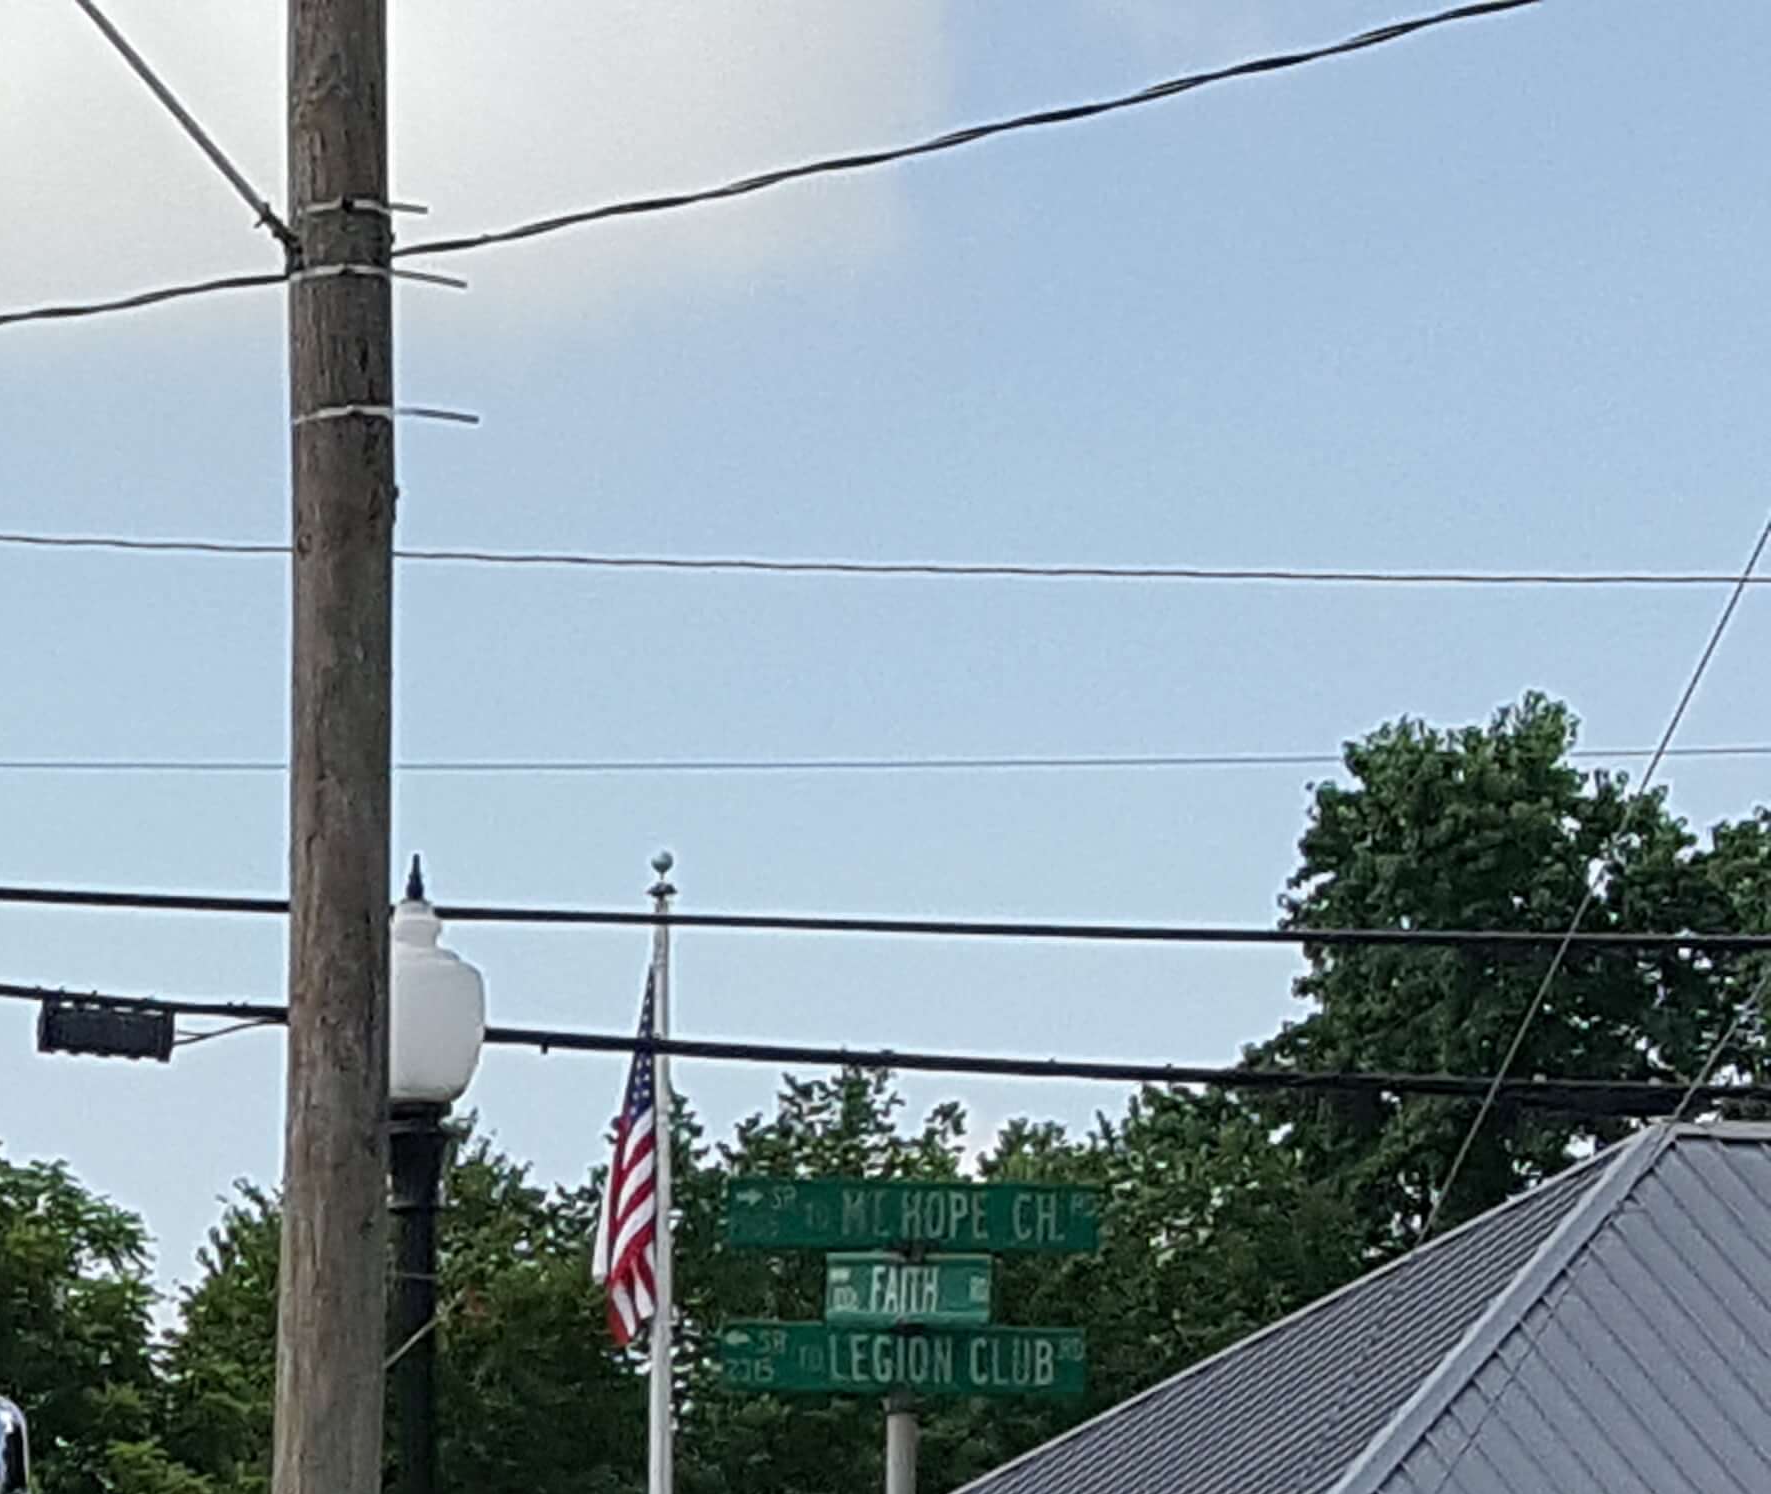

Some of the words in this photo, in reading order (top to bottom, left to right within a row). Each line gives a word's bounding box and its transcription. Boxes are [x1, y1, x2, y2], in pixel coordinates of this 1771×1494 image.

[901, 1190, 988, 1241] HOPE
[870, 1265, 939, 1313] FAITH
[828, 1334, 954, 1384] LEGION
[969, 1336, 1055, 1387] CLUB
